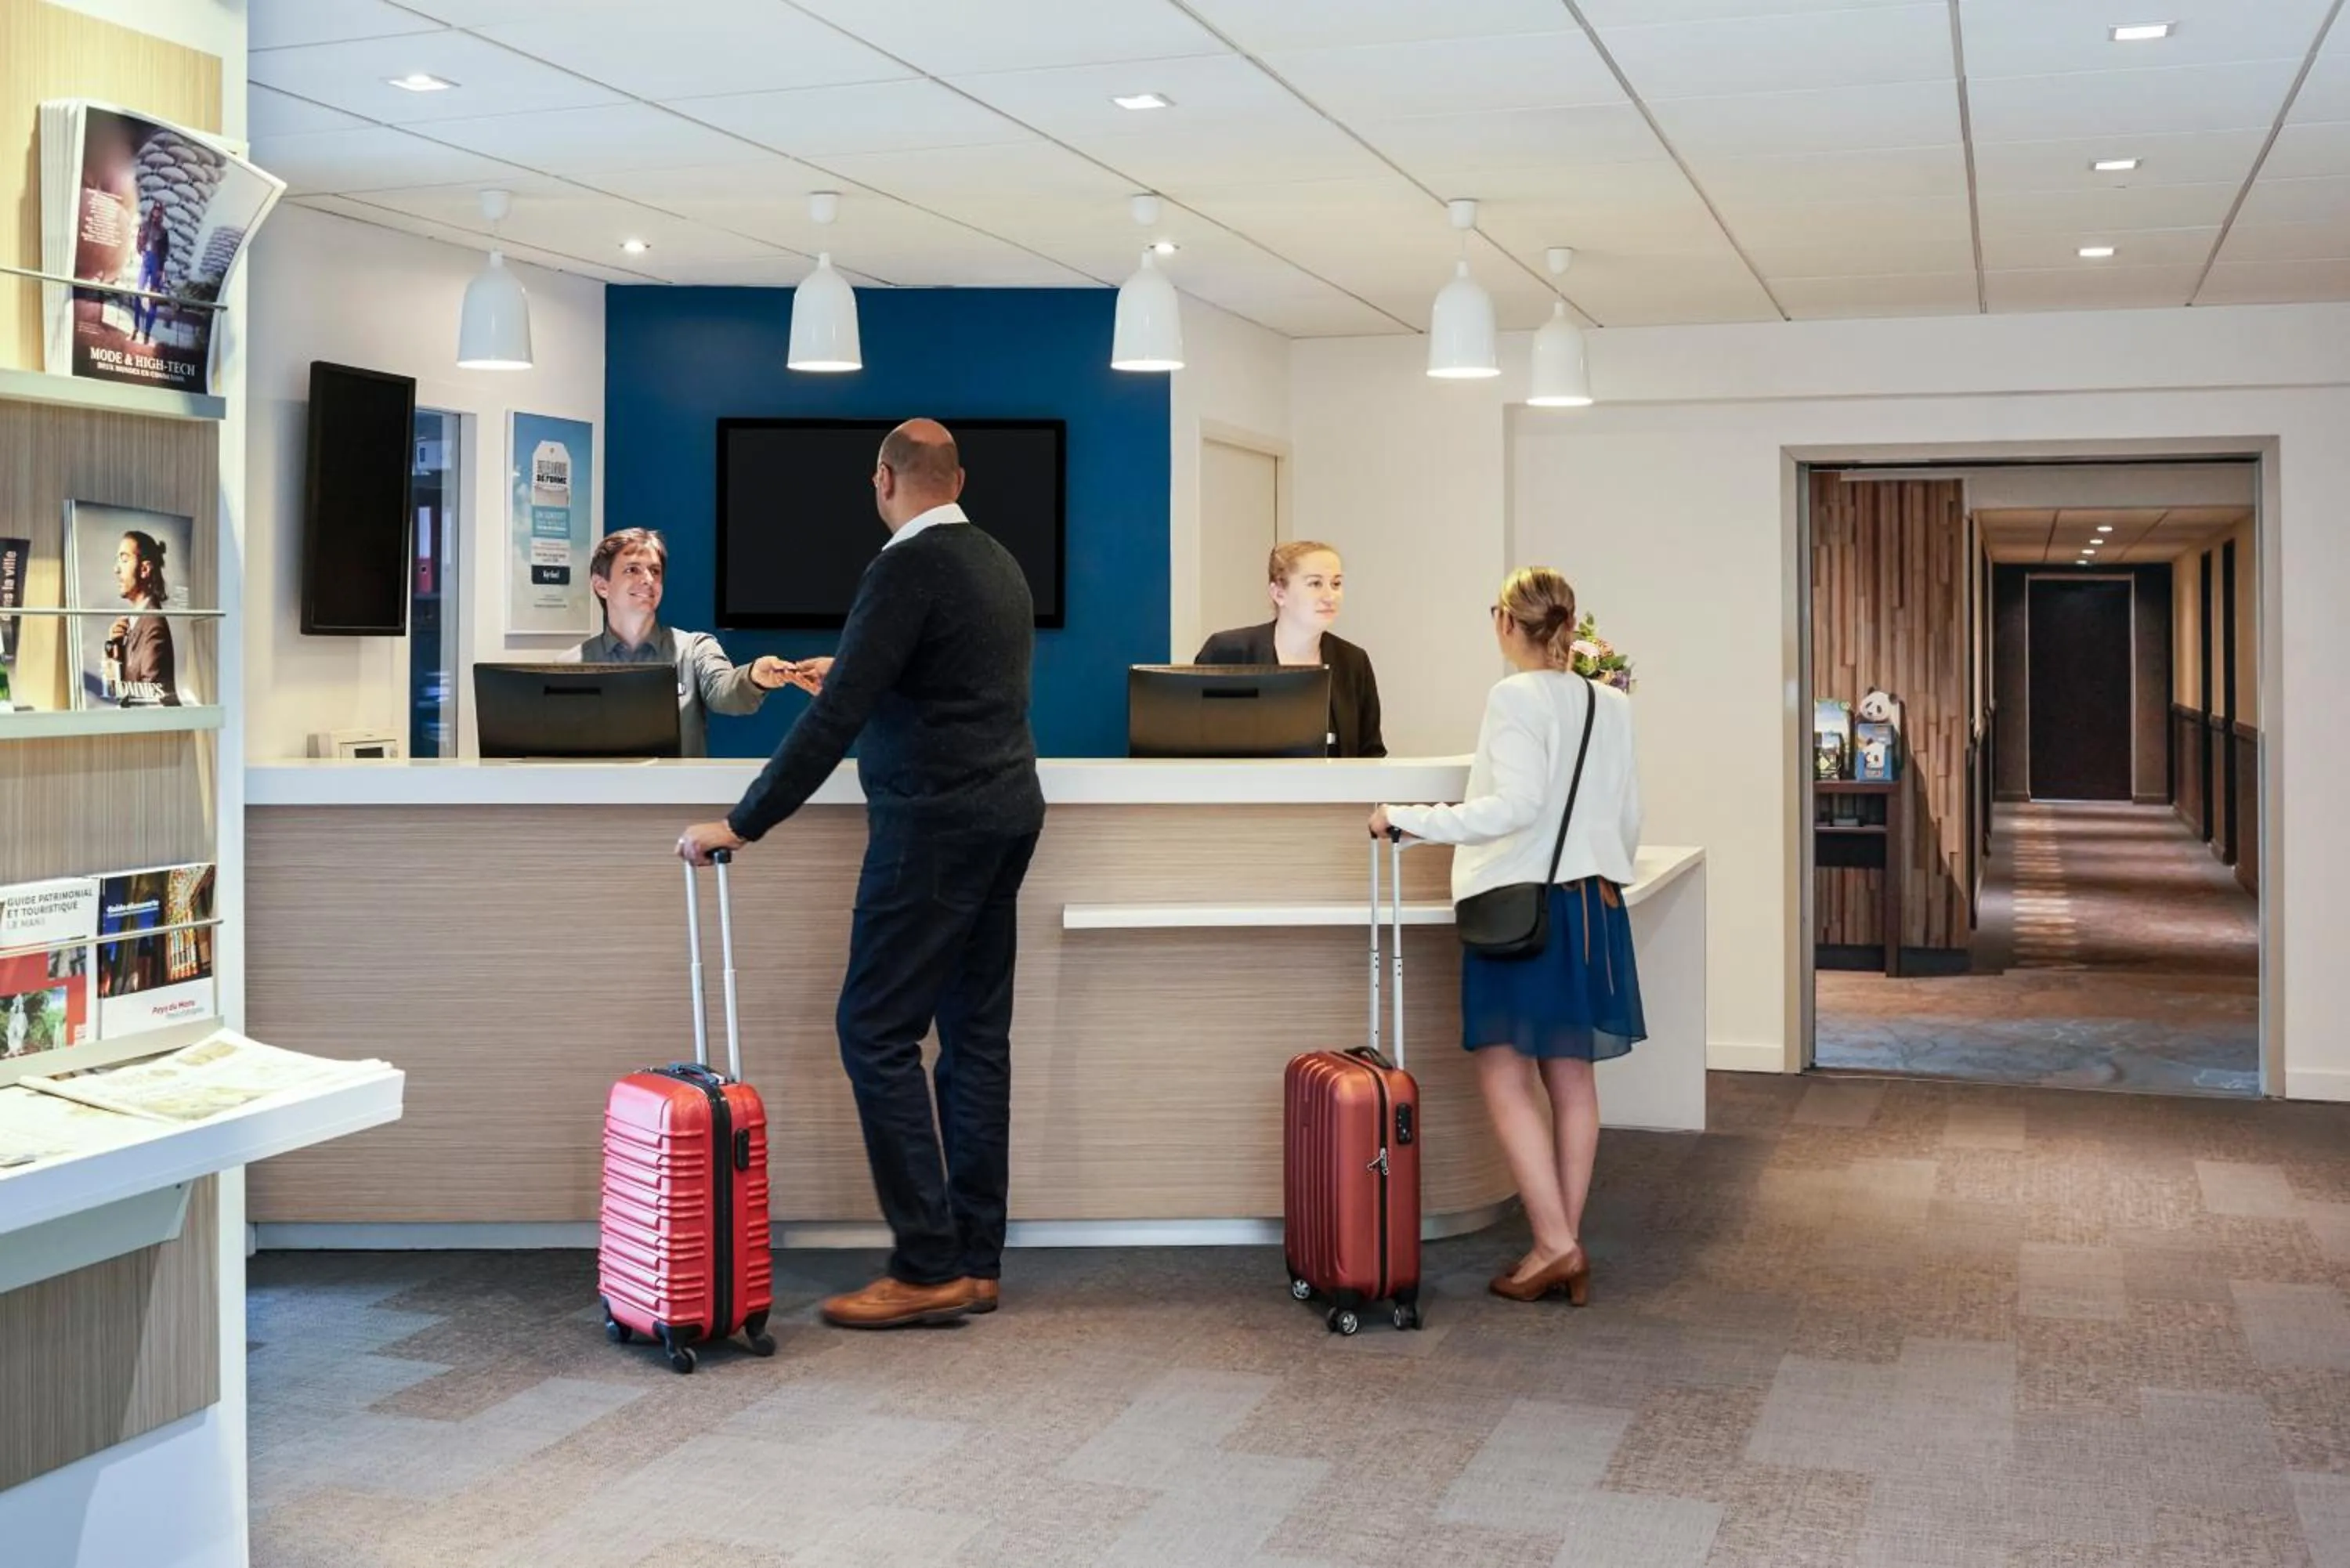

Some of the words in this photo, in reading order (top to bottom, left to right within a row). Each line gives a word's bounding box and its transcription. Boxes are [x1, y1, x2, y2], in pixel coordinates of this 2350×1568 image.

[90, 346, 124, 364] MODE
[125, 353, 133, 366] &
[135, 354, 196, 376] HIGH-TECH
[2, 551, 16, 576] ville
[7, 895, 36, 906] GUIDE
[38, 888, 92, 903] PATRIMONIAL
[7, 909, 18, 919] ET
[21, 901, 78, 916] TOURISTIQUE
